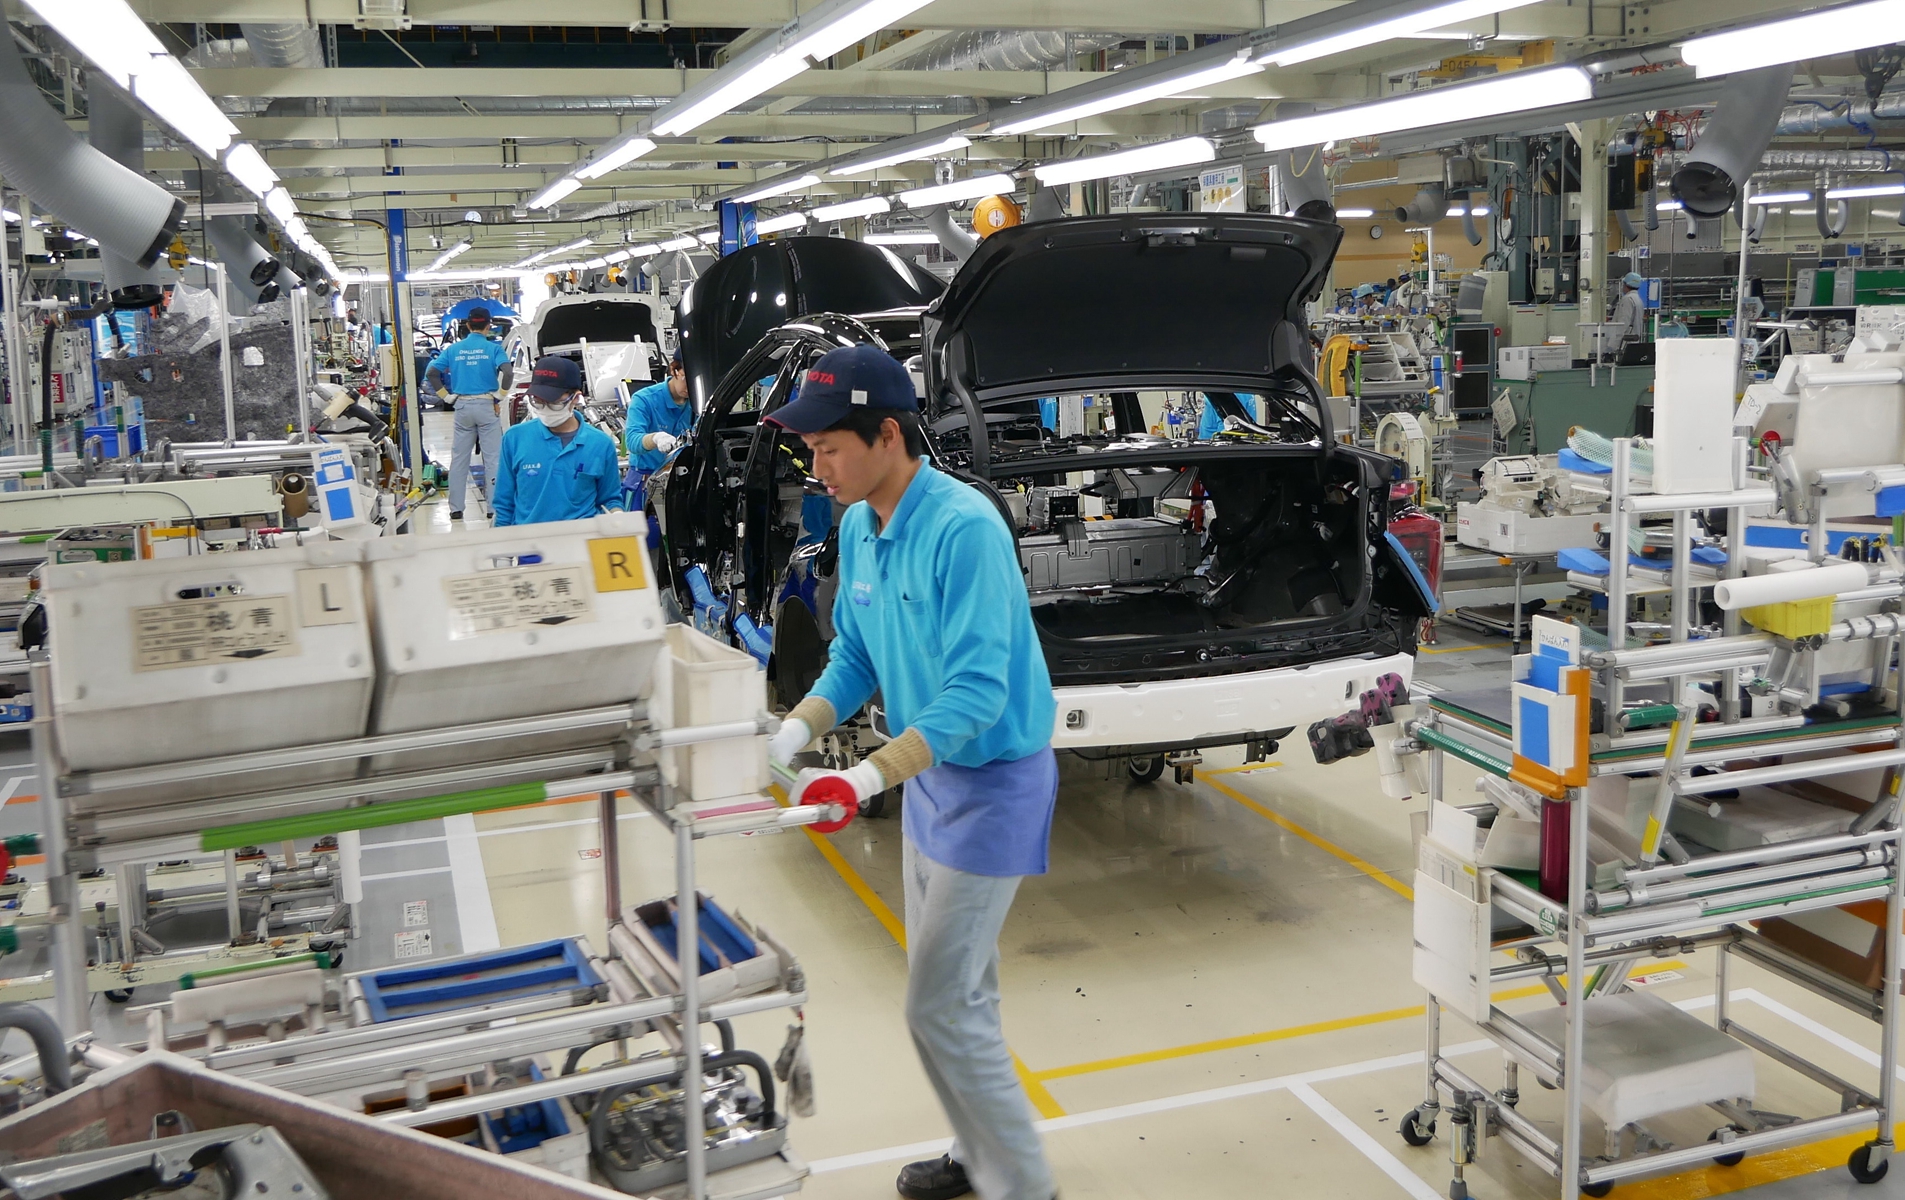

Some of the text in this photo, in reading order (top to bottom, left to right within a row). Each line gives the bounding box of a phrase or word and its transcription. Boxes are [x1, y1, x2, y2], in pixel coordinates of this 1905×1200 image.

[608, 551, 633, 579] R
[320, 583, 344, 612] L
[1767, 700, 1774, 709] 3
